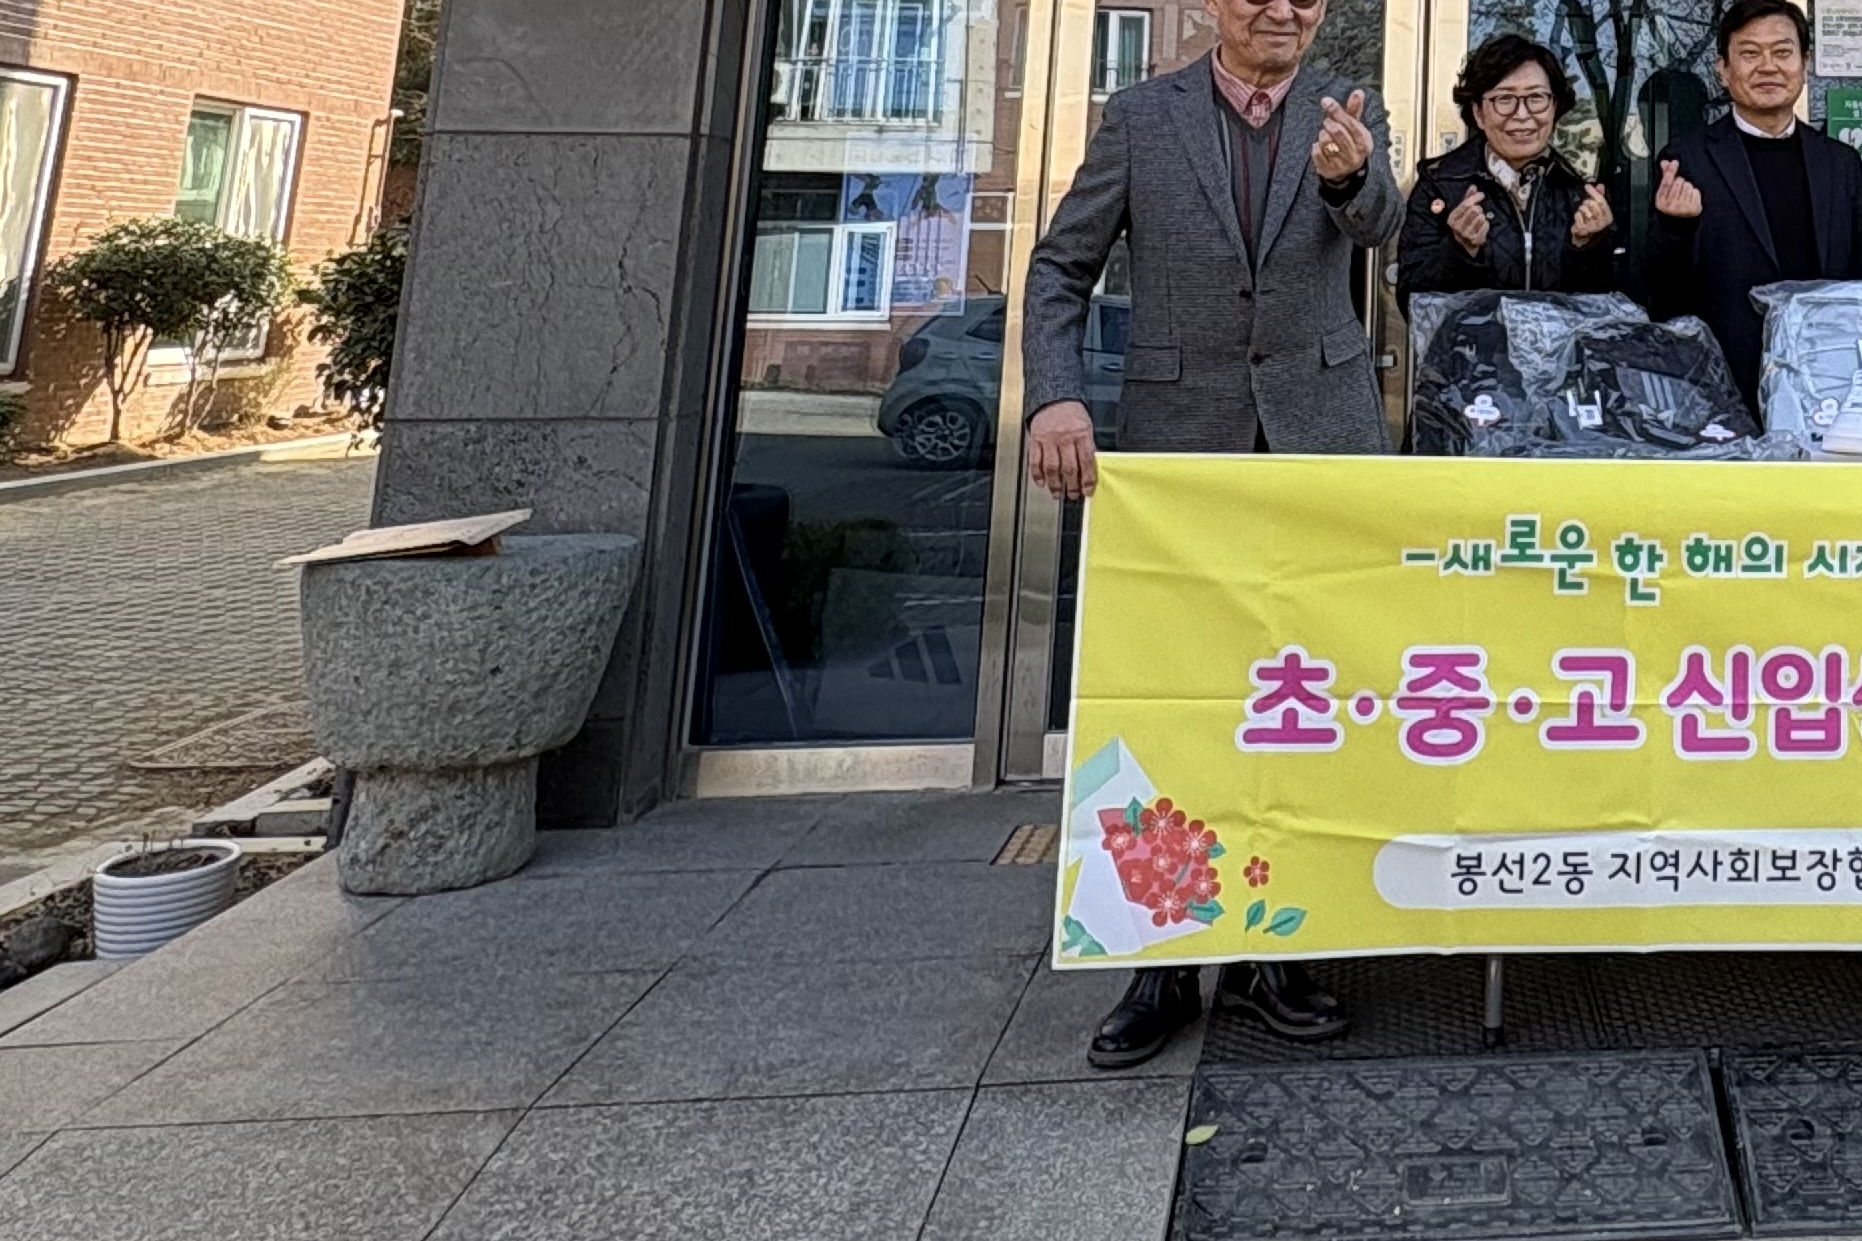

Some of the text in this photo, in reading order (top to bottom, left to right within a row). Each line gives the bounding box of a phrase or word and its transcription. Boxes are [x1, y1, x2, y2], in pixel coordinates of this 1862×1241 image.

[1614, 537, 1664, 603] 한
[1685, 536, 1784, 576] 해의
[1242, 653, 1640, 758] 초·중·고
[1450, 850, 1594, 897] 봉선2동
